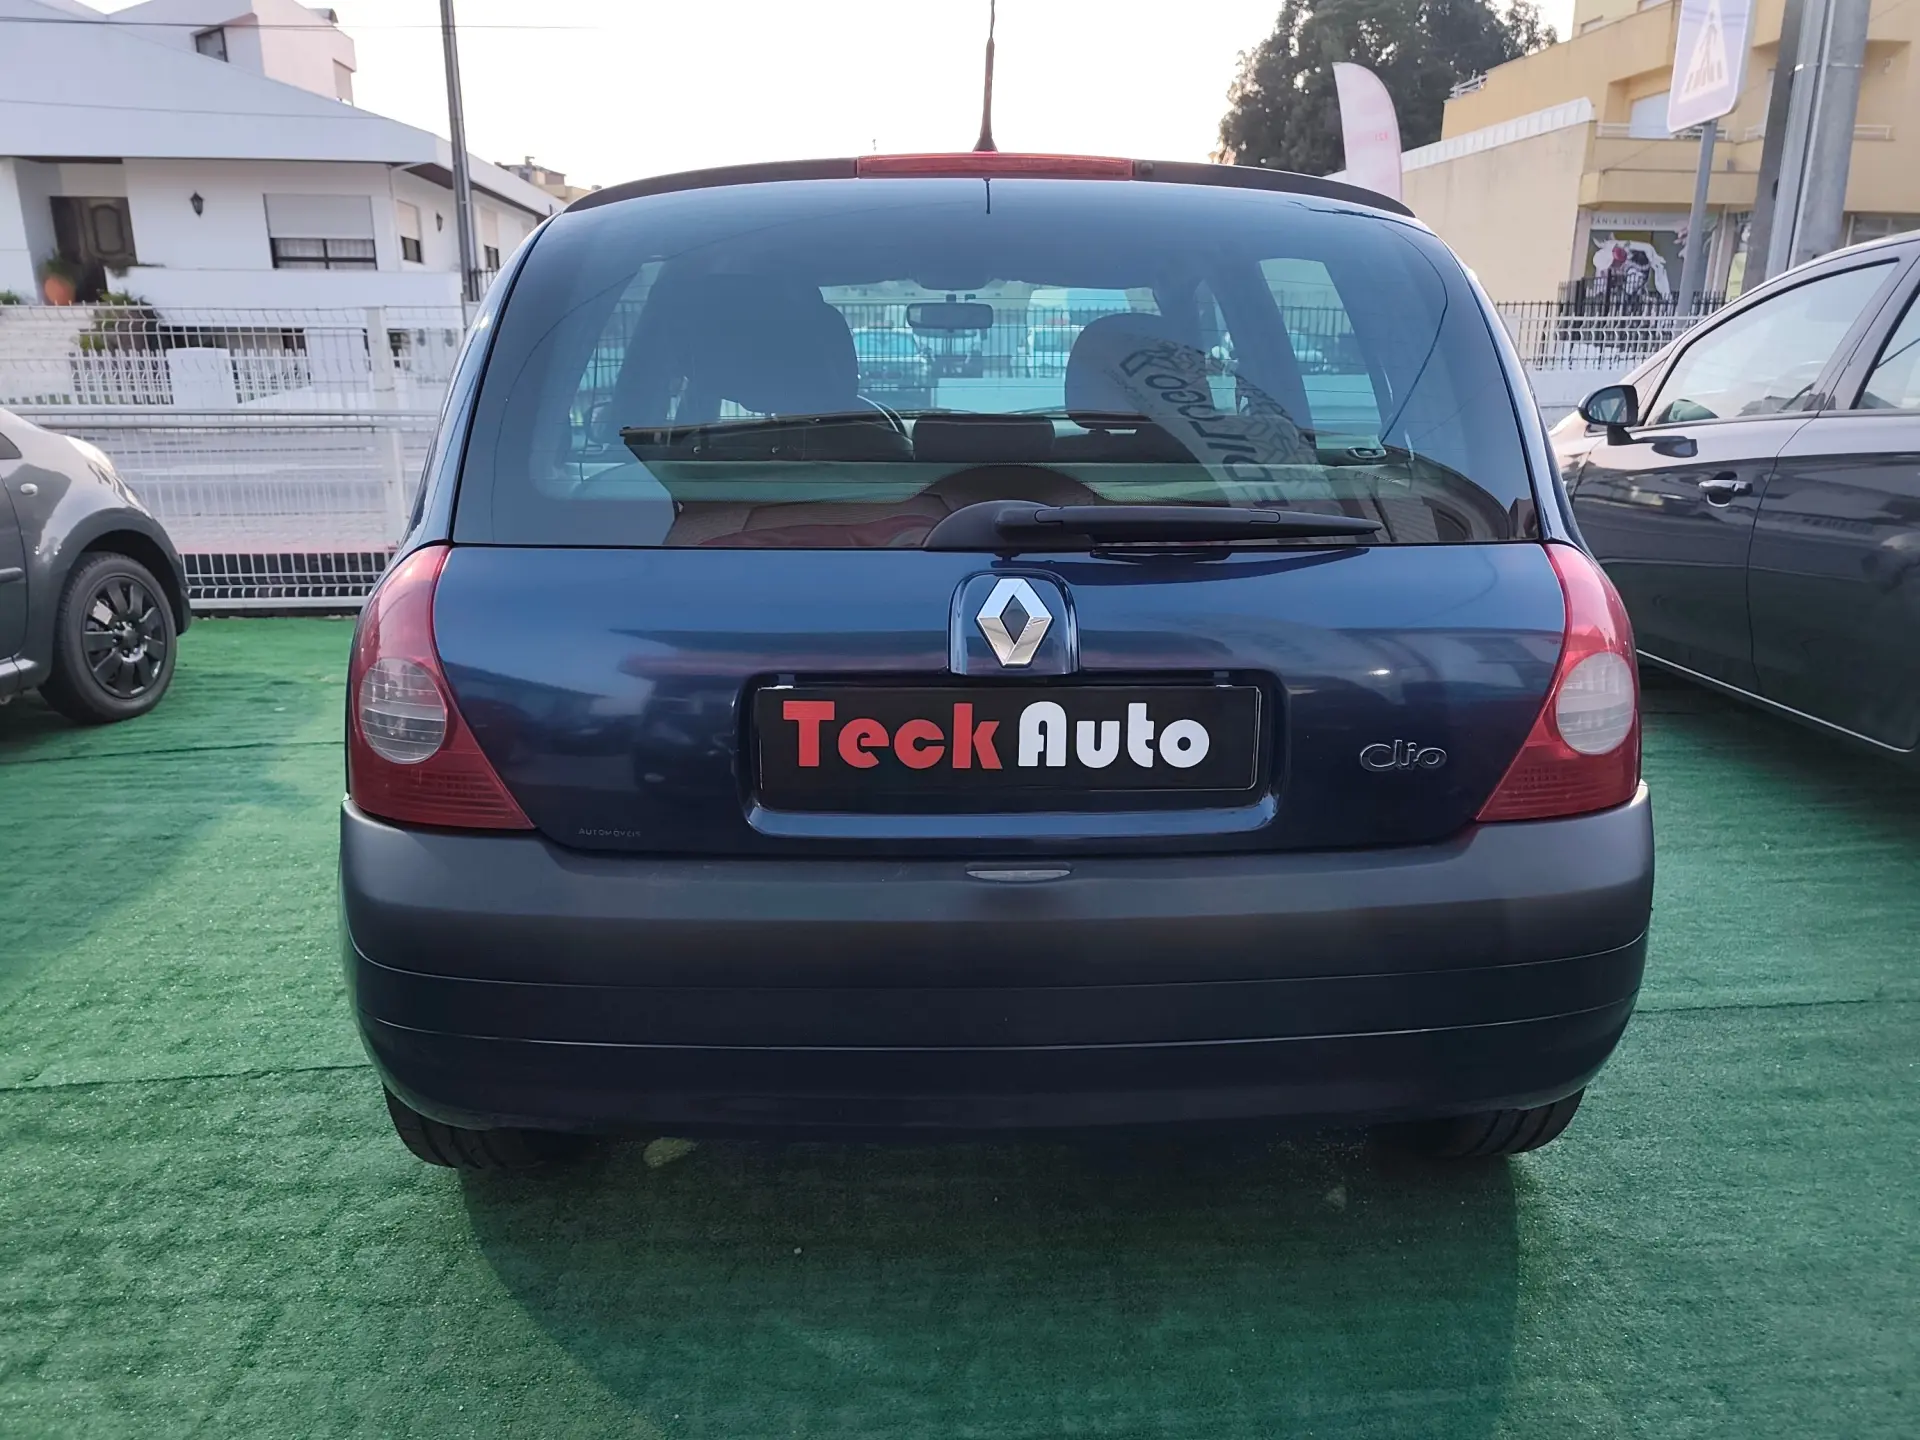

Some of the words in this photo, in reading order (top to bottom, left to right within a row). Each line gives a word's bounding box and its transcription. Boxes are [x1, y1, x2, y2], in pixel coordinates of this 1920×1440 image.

[783, 700, 1003, 770] Teck
[1018, 701, 1210, 768] Auto
[1360, 739, 1447, 772] Clio
